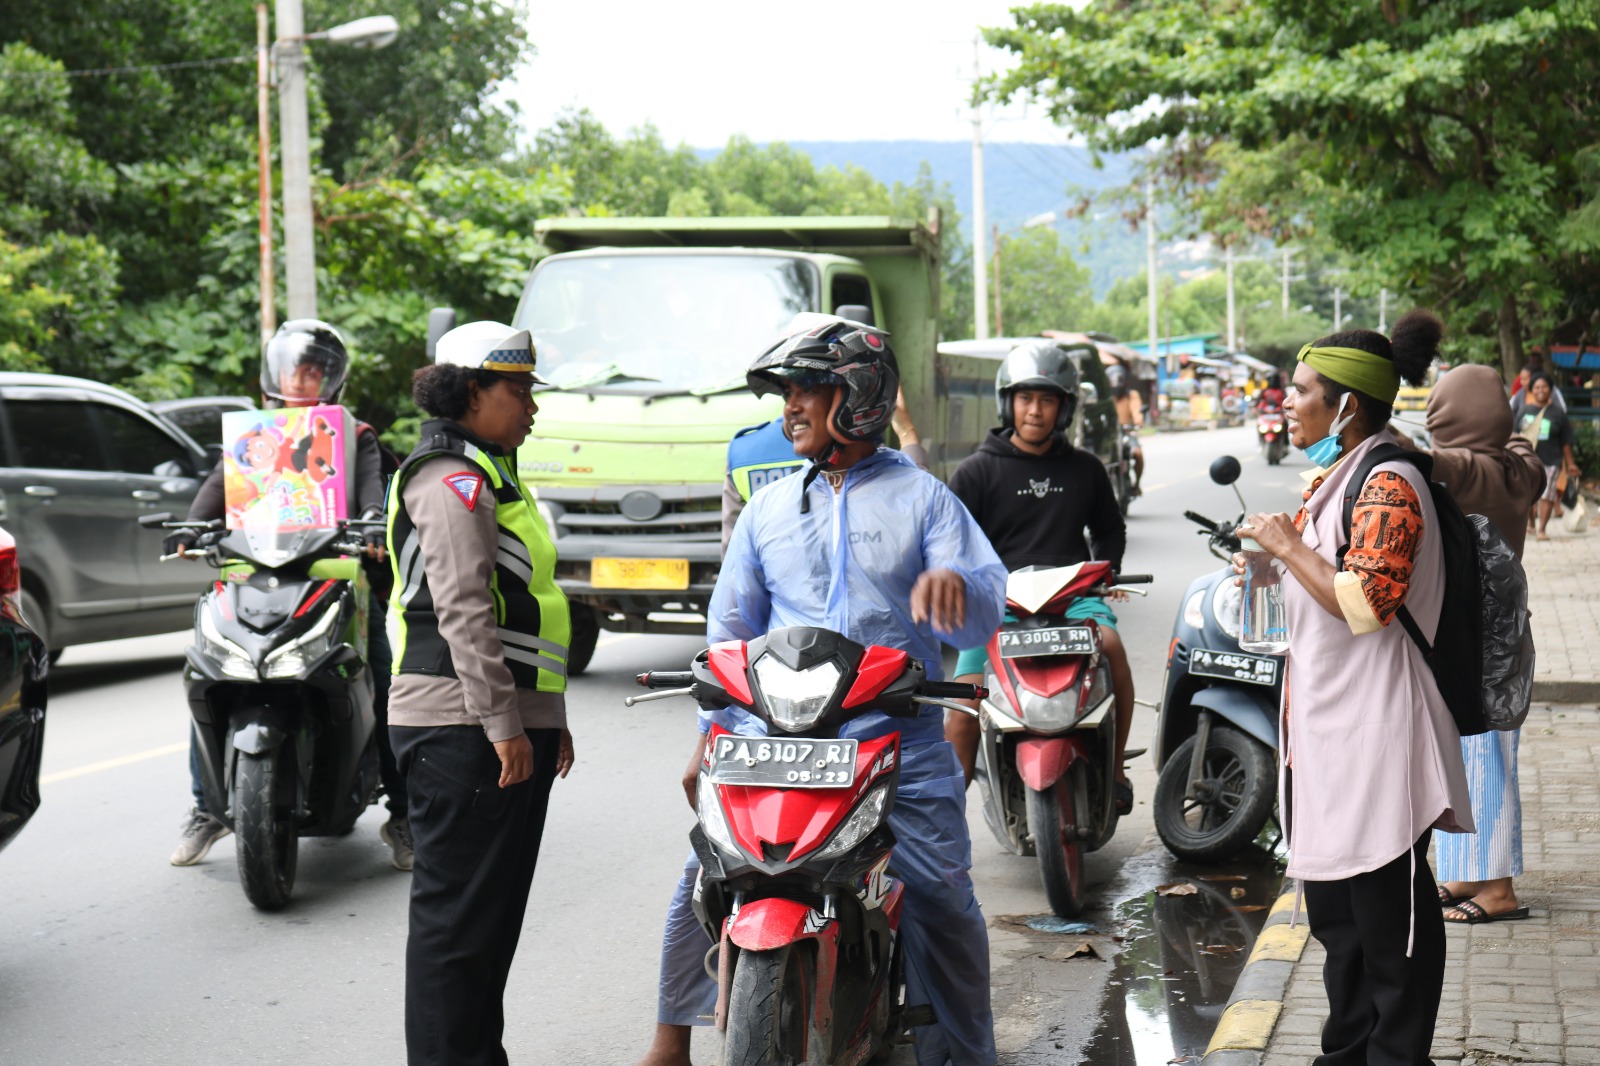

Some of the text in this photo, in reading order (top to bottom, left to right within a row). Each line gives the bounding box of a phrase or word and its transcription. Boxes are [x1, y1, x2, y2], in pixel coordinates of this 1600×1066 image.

[1001, 629, 1088, 646] PA 3005 RM
[1193, 651, 1212, 665] PA
[1255, 660, 1274, 673] RU
[719, 739, 852, 764] PA 6107 RI
